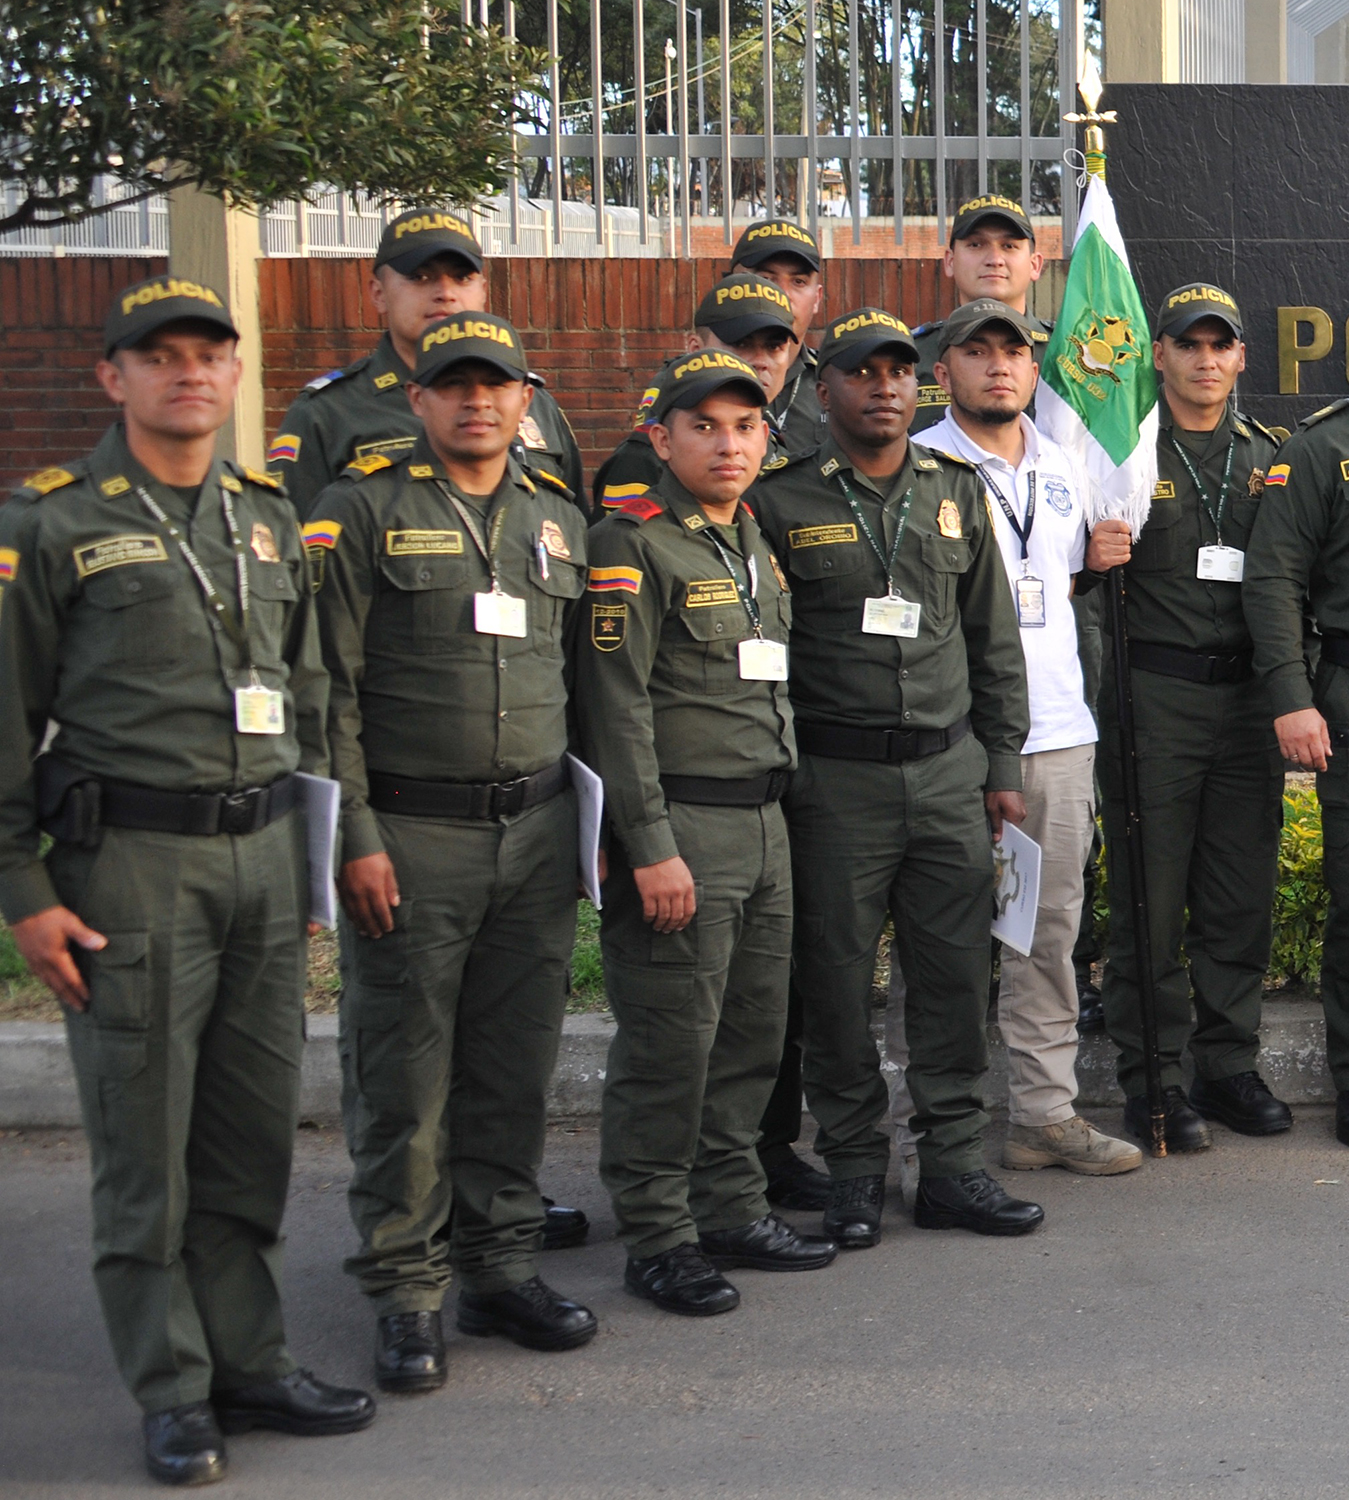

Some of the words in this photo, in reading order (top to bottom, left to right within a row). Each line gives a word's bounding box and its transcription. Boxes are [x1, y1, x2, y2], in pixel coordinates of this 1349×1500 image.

[958, 196, 1026, 217] POLICIA
[395, 214, 474, 241] POLICIA
[747, 222, 815, 247] POLICIA
[121, 277, 225, 316] POLICIA
[716, 283, 792, 313] POLICIA
[1167, 286, 1237, 310] POLICIA
[421, 320, 515, 352] POLICIA
[833, 310, 911, 340] POLICIA
[674, 352, 758, 380] POLICIA
[1056, 354, 1087, 385] CURSO
